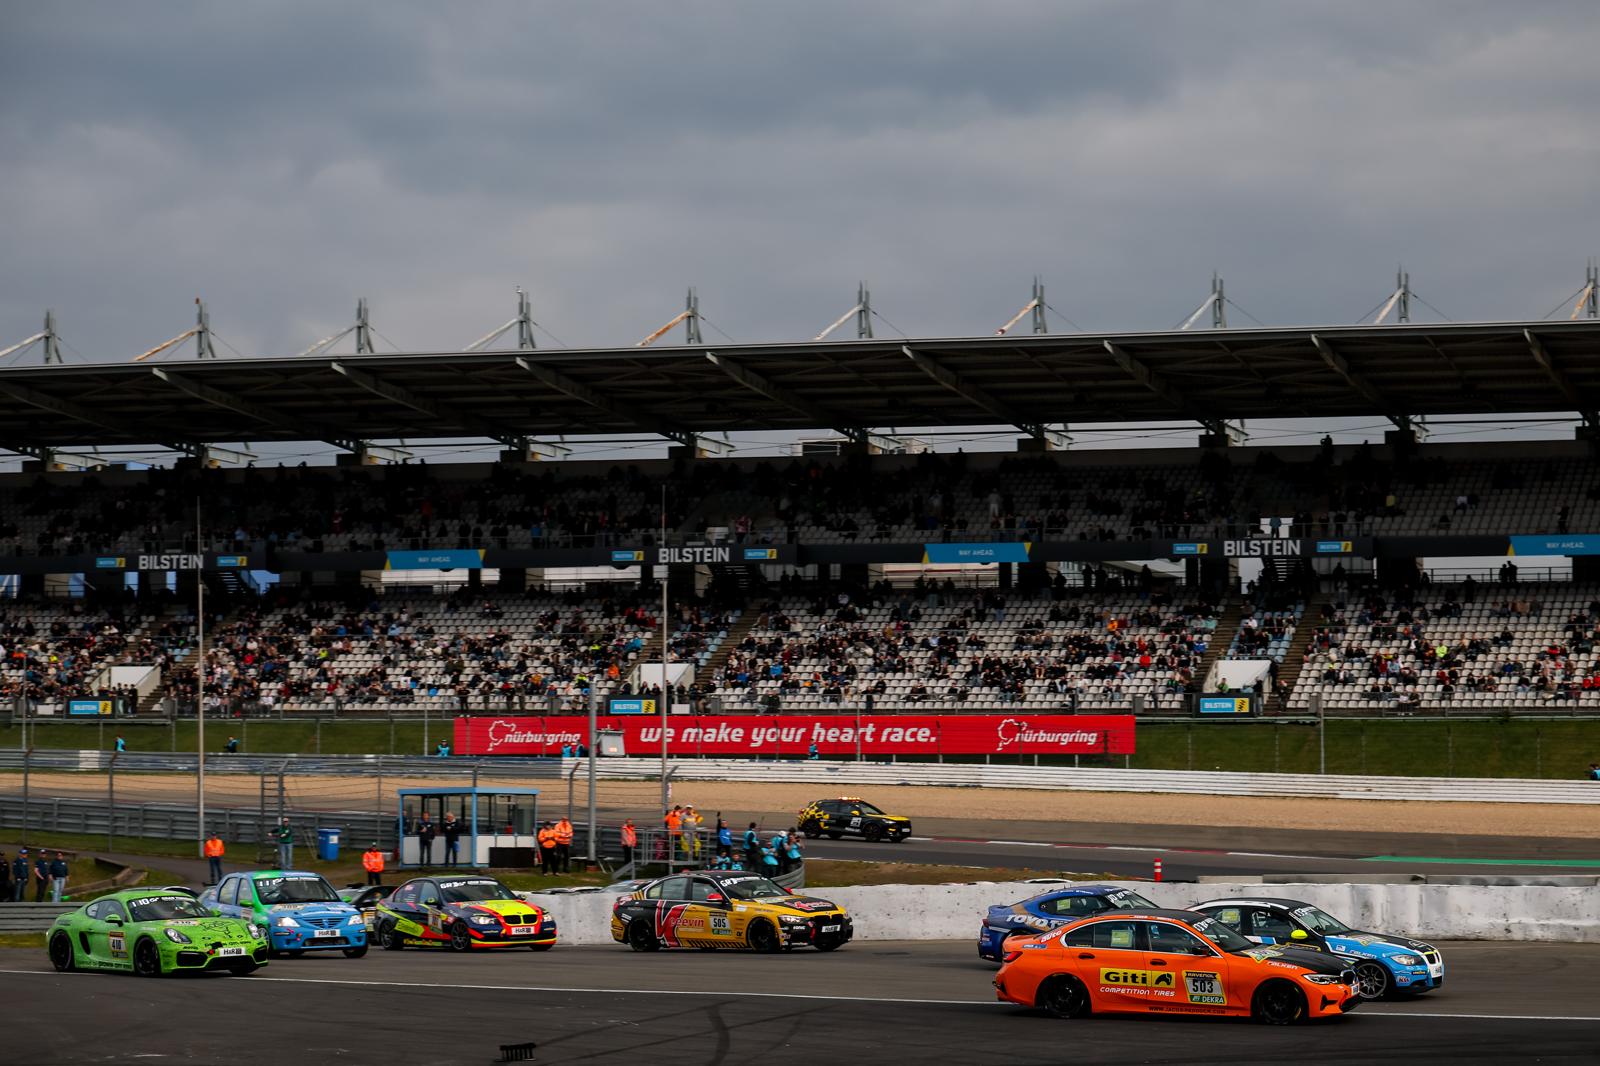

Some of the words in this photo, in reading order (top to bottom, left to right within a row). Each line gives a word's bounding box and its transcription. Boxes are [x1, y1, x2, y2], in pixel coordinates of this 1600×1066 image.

[1224, 540, 1300, 556] BILSTEIN
[138, 555, 203, 569] BILSTEIN
[658, 548, 730, 563] BILSTEIN
[504, 729, 581, 746] nürburgring
[640, 727, 674, 743] we
[682, 723, 743, 743] make
[750, 727, 805, 750] your
[811, 723, 875, 743] heart
[881, 727, 937, 743] race.
[1014, 728, 1097, 746] nürburgring
[713, 918, 727, 927] 505
[112, 939, 122, 949] 410
[1104, 972, 1147, 984] Giti
[1099, 986, 1150, 996] COMPETITION
[1192, 979, 1214, 993] 503
[1202, 996, 1224, 1004] DEKRA
